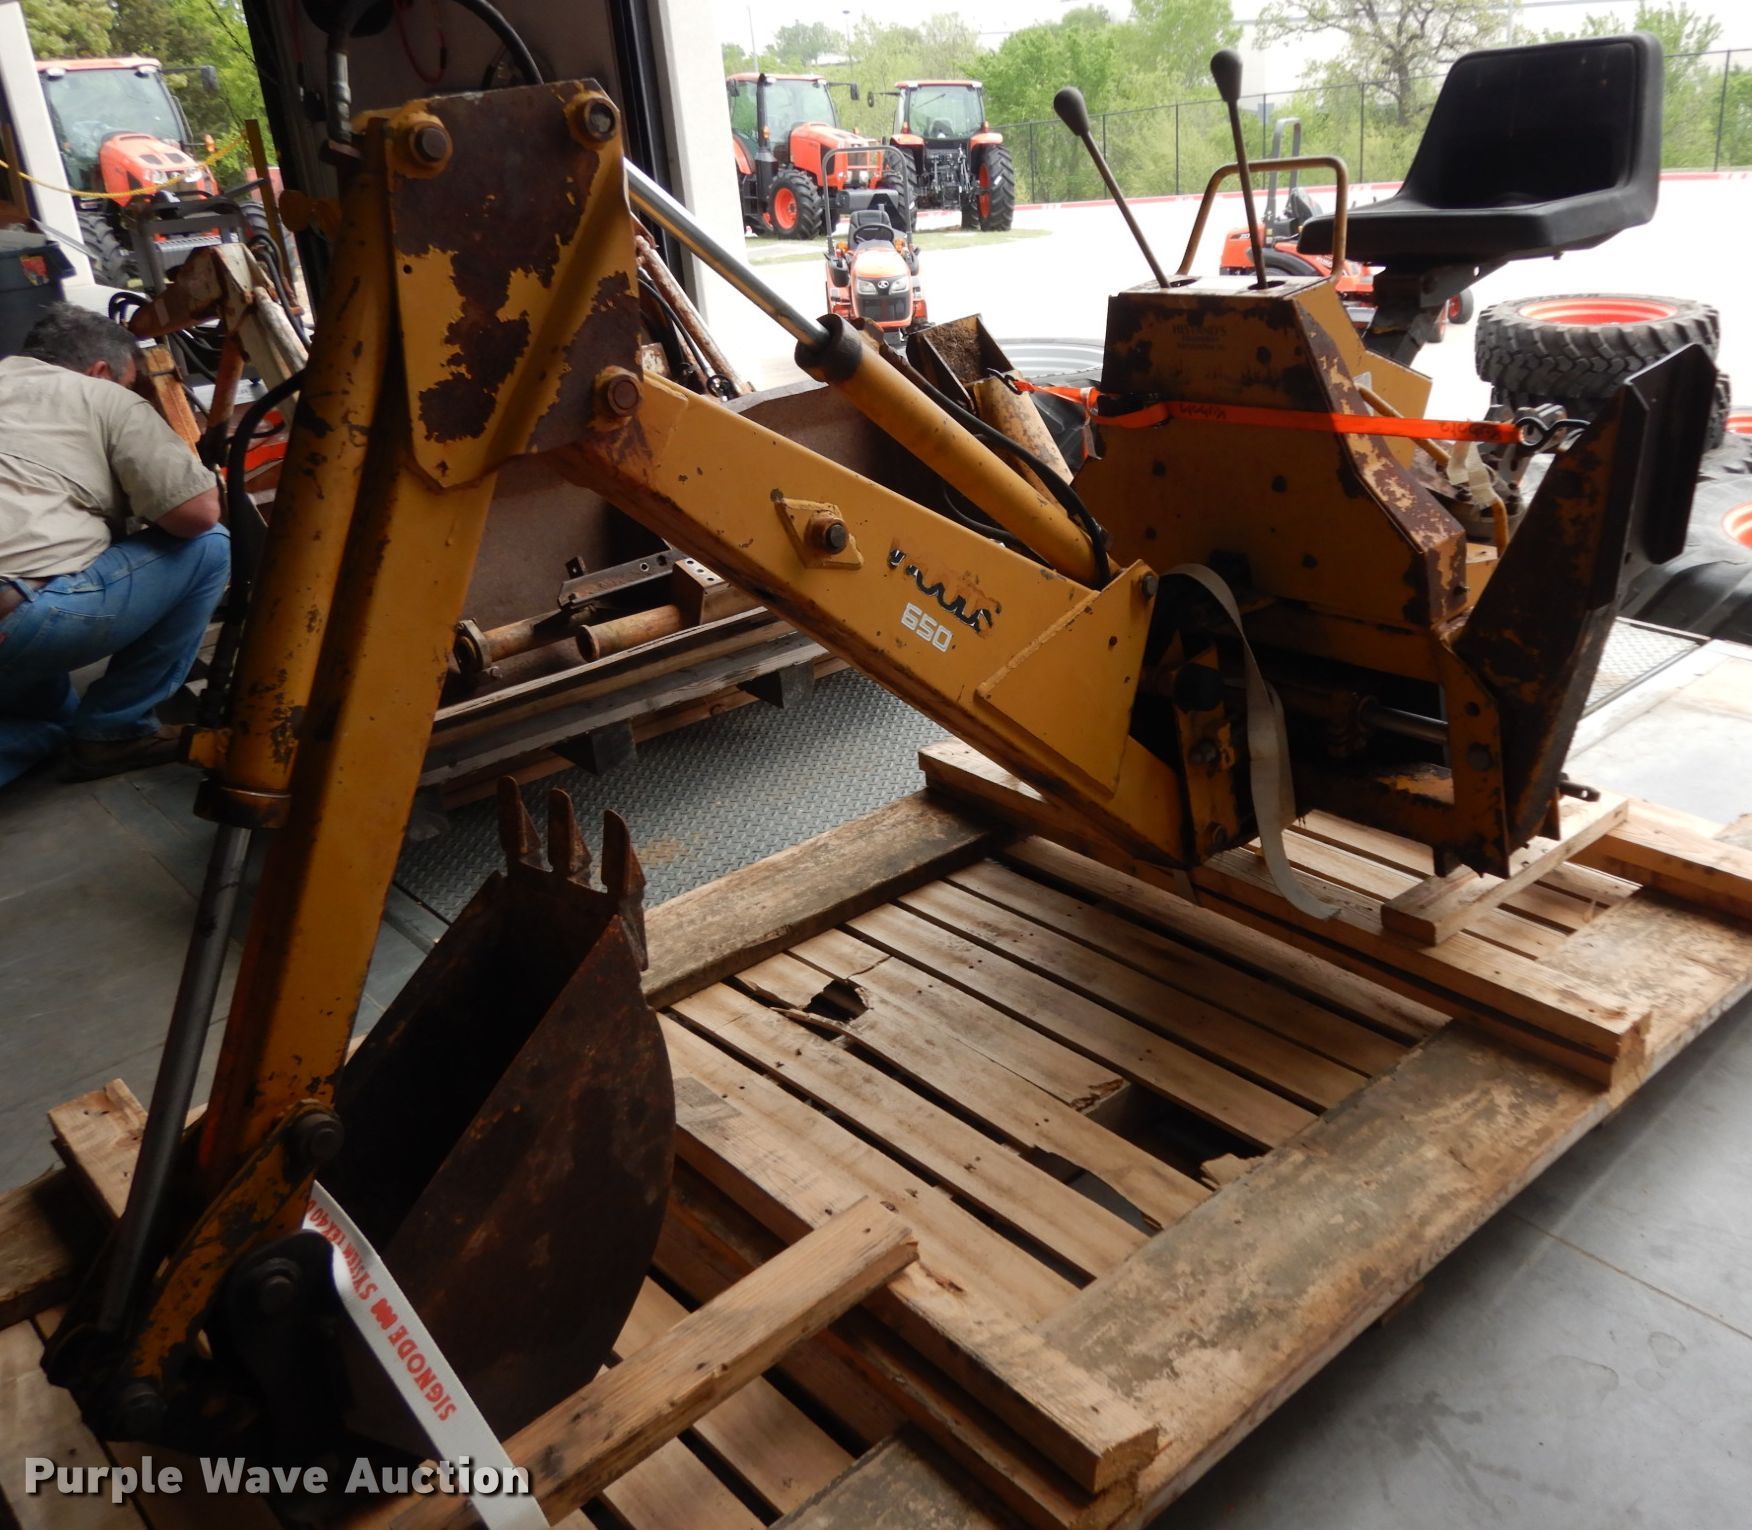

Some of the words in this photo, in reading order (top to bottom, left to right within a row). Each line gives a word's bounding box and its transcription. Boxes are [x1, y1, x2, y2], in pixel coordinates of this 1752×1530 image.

[901, 602, 953, 652] 650
[342, 1243, 379, 1300] SYSTEM
[387, 1325, 457, 1421] SIGNODE
